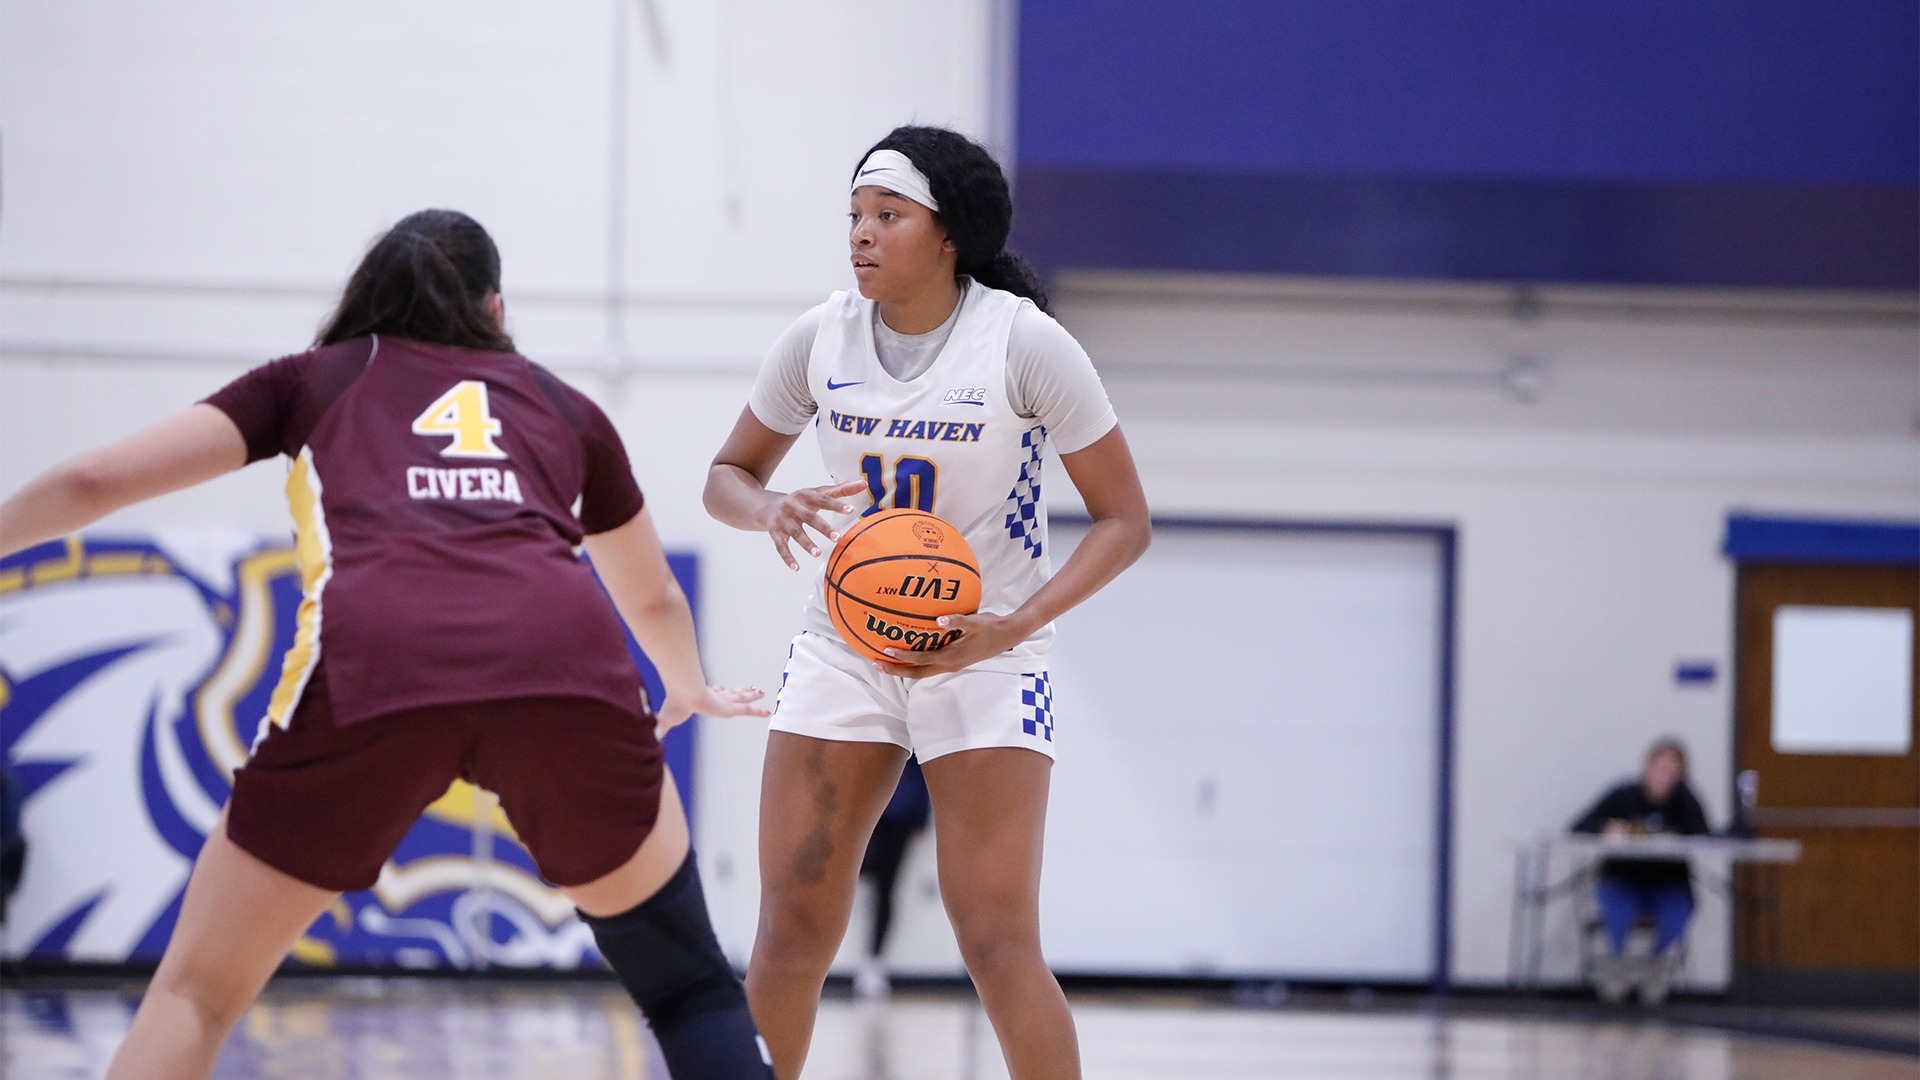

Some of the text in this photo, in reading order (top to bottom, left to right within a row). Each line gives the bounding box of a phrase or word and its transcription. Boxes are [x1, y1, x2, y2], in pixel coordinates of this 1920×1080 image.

[943, 387, 987, 402] NEC
[411, 380, 509, 460] 4
[830, 409, 987, 442] NEW HAVEN
[406, 466, 524, 505] CIVERA
[858, 452, 939, 520] 10
[875, 575, 961, 601] EVO NXT
